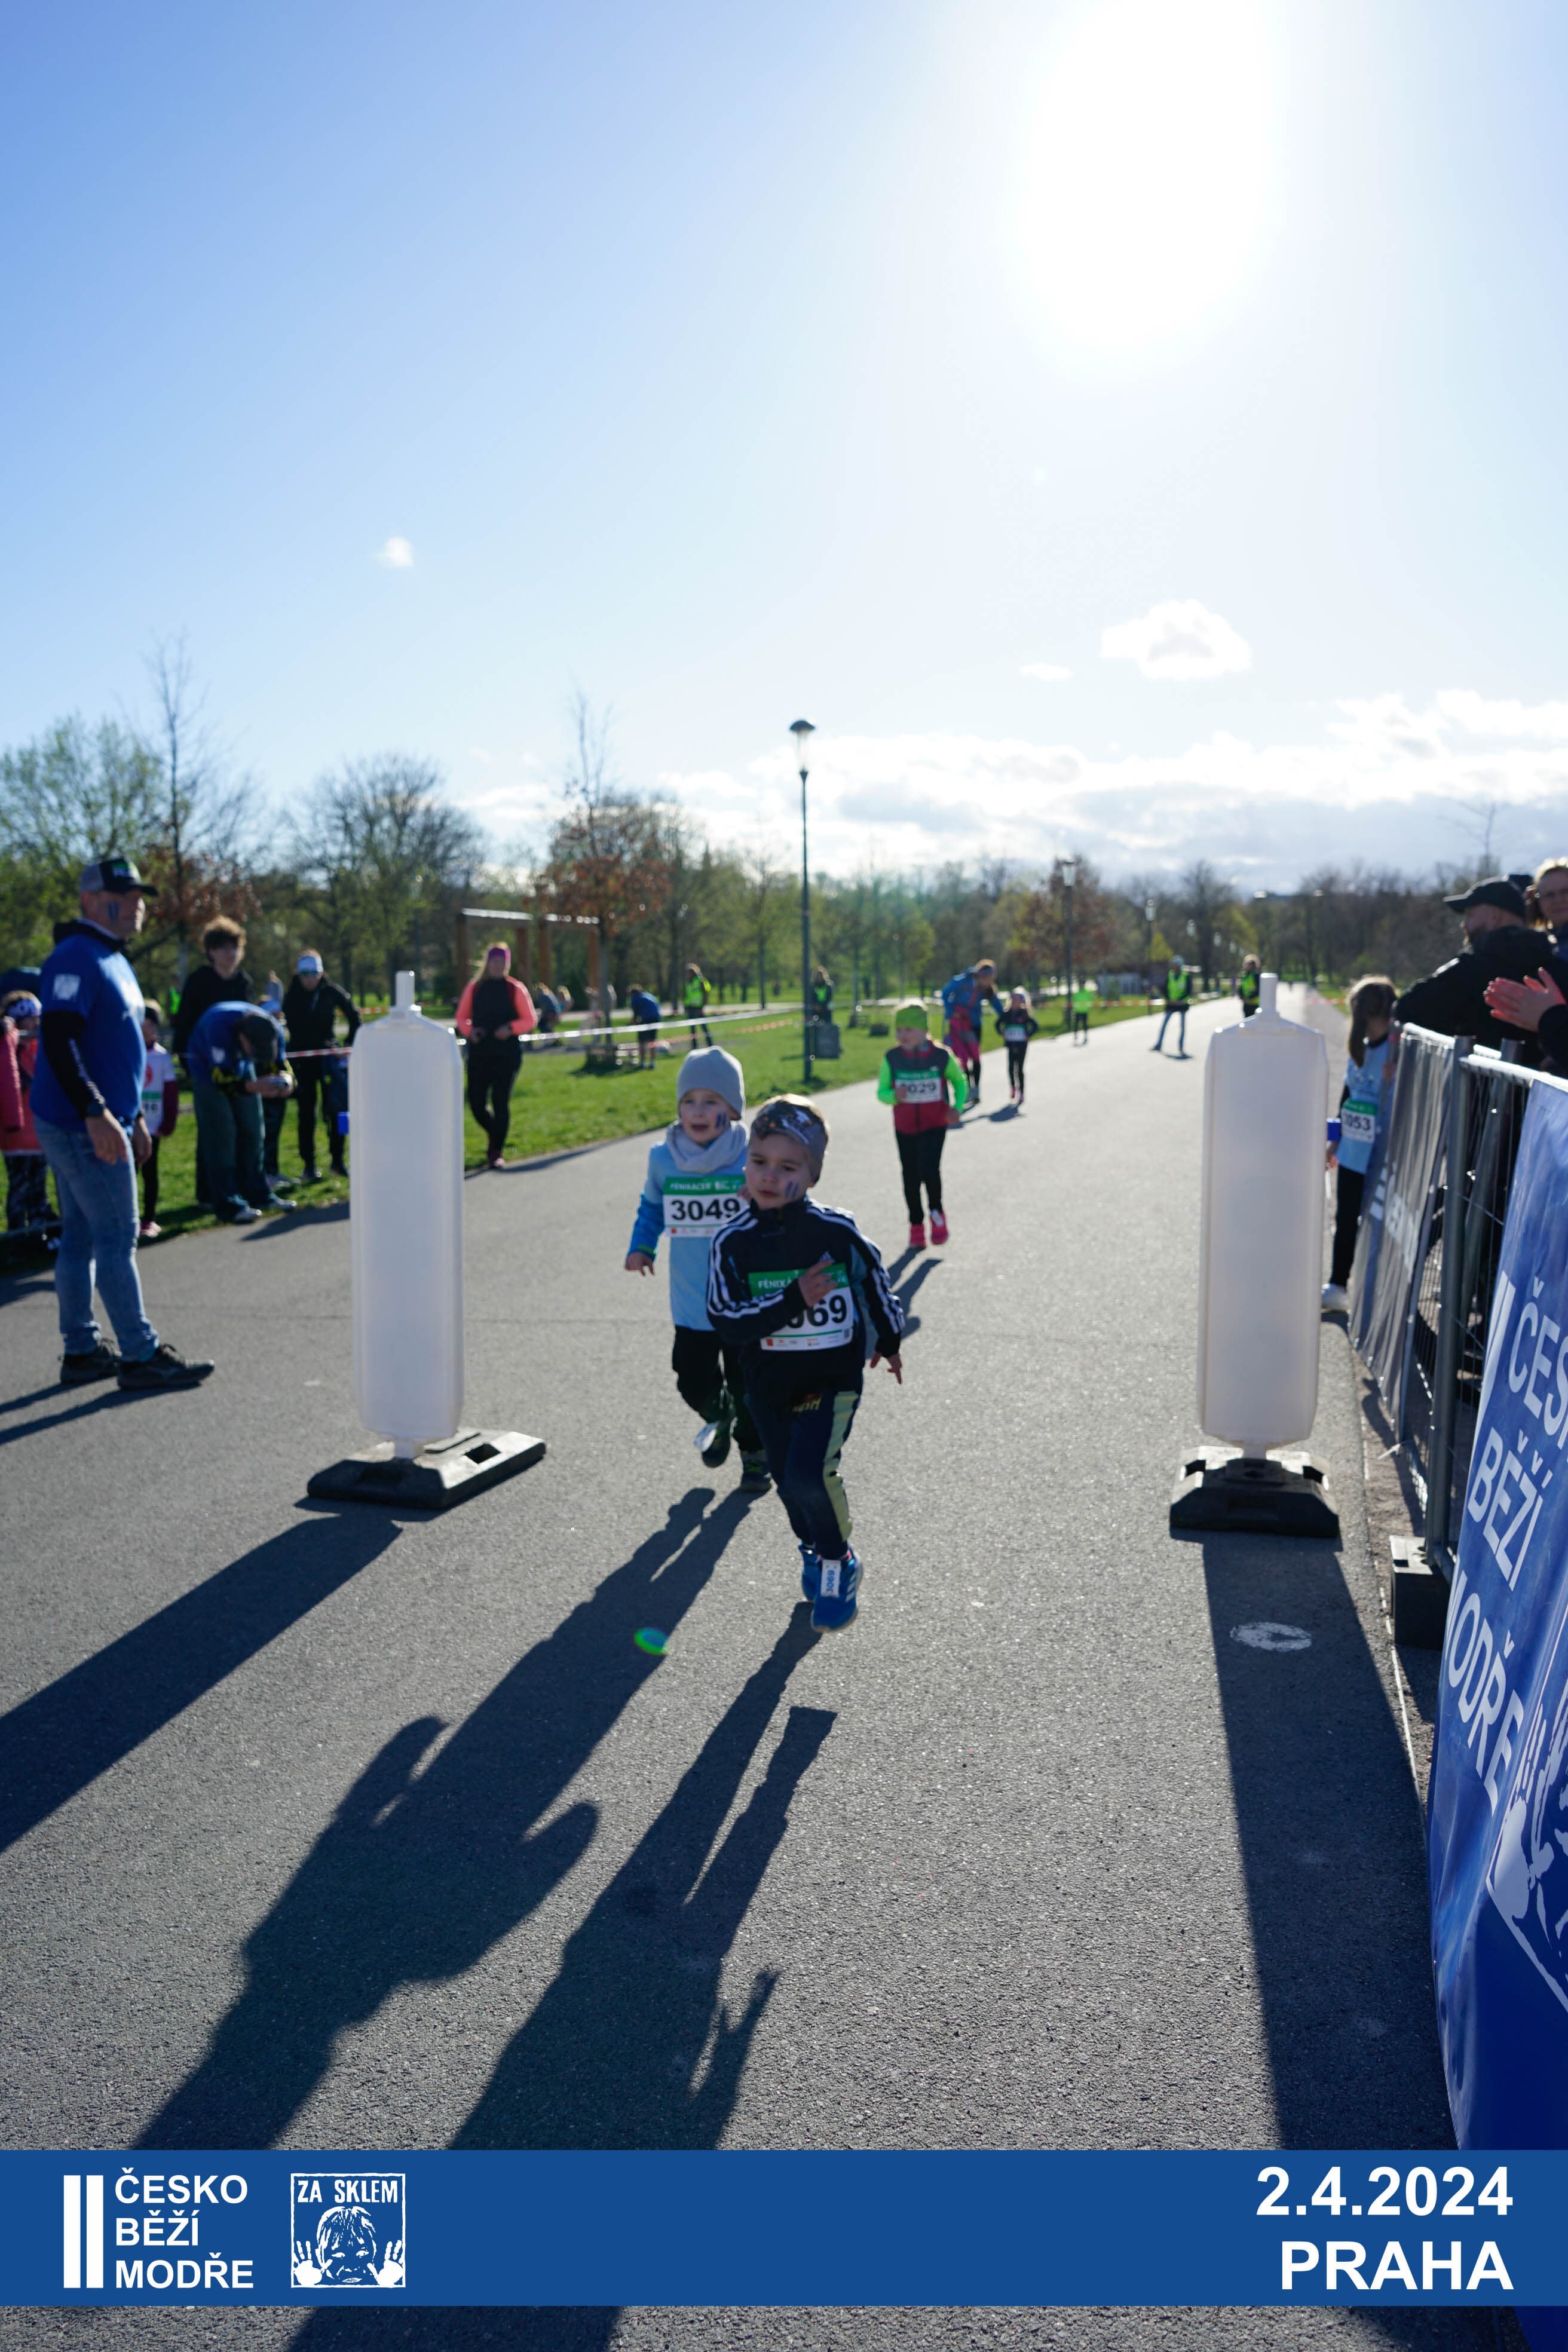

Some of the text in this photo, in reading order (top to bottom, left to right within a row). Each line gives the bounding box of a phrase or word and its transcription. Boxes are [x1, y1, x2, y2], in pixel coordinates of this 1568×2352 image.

[670, 1198, 740, 1220] 3049
[1509, 1275, 1568, 1450] ČES
[1468, 1426, 1553, 1591] BĚŽÍ
